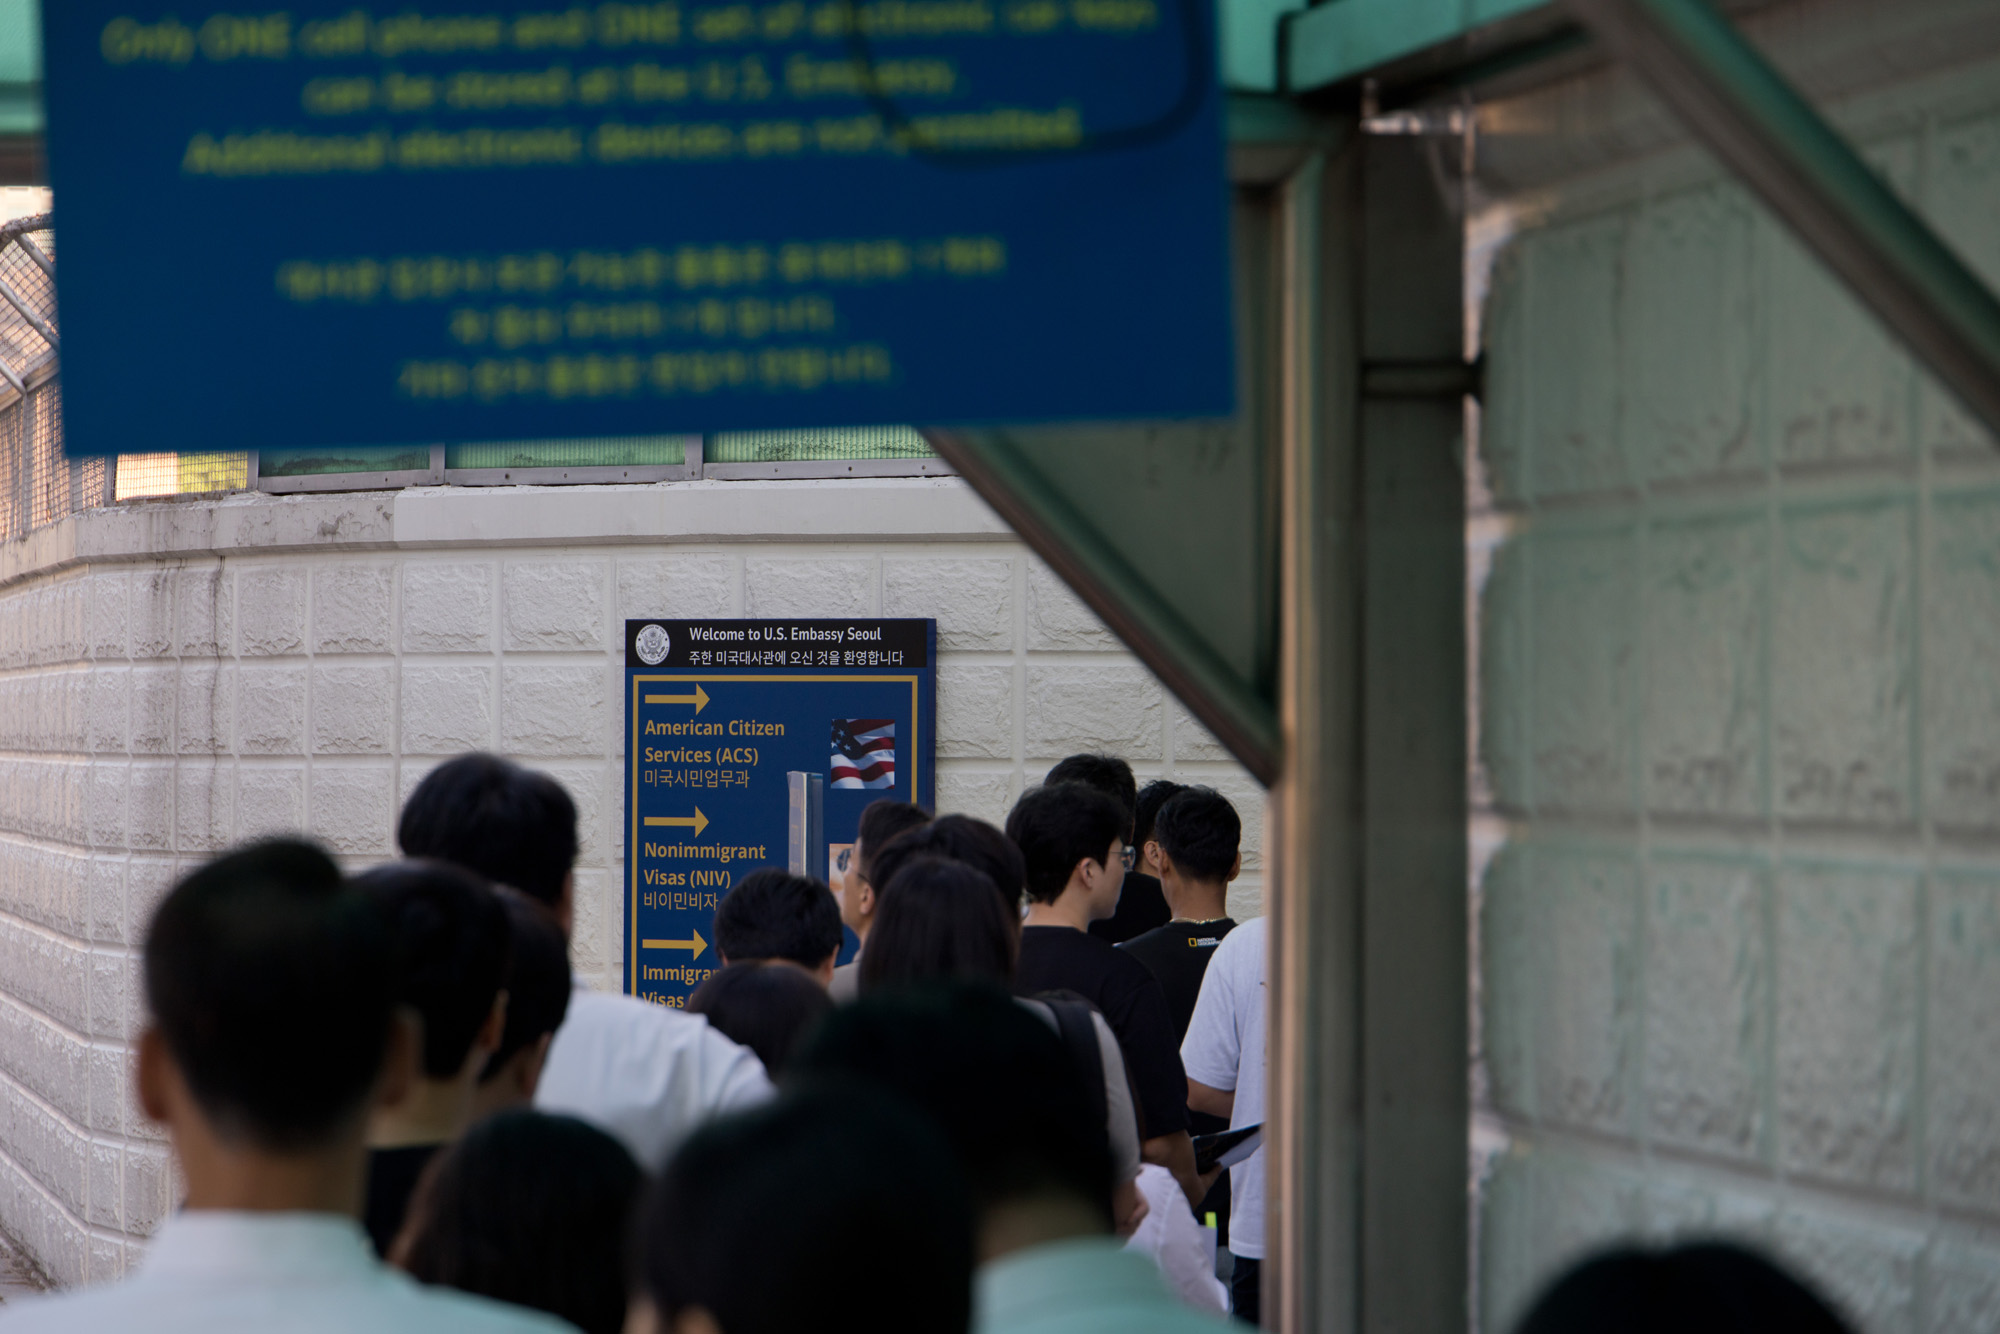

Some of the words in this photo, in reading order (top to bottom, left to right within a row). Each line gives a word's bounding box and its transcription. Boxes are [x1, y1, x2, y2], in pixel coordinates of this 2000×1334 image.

[204, 14, 292, 59] ONE
[599, 5, 681, 46] ONE
[689, 627, 745, 641] Welcome
[748, 628, 761, 641] to
[764, 627, 788, 641] U.S.
[791, 627, 844, 643] Embassy
[847, 627, 881, 641] Seoul
[689, 650, 713, 665] 주한
[716, 650, 786, 665] 미국대사관에
[790, 650, 813, 665] 오신
[817, 650, 841, 665] 것을
[844, 650, 904, 665] 환영합니다
[644, 719, 724, 736] American
[728, 719, 785, 736] Citizen
[644, 747, 712, 763] Services
[716, 747, 759, 766] (ACS)
[644, 768, 750, 788] 미국시민업무과
[644, 842, 766, 863] Nonimmigrant
[643, 869, 686, 885] Visas
[690, 870, 731, 889] (NIV)
[643, 891, 719, 911] 비이민비자
[642, 991, 685, 1008] Visas
